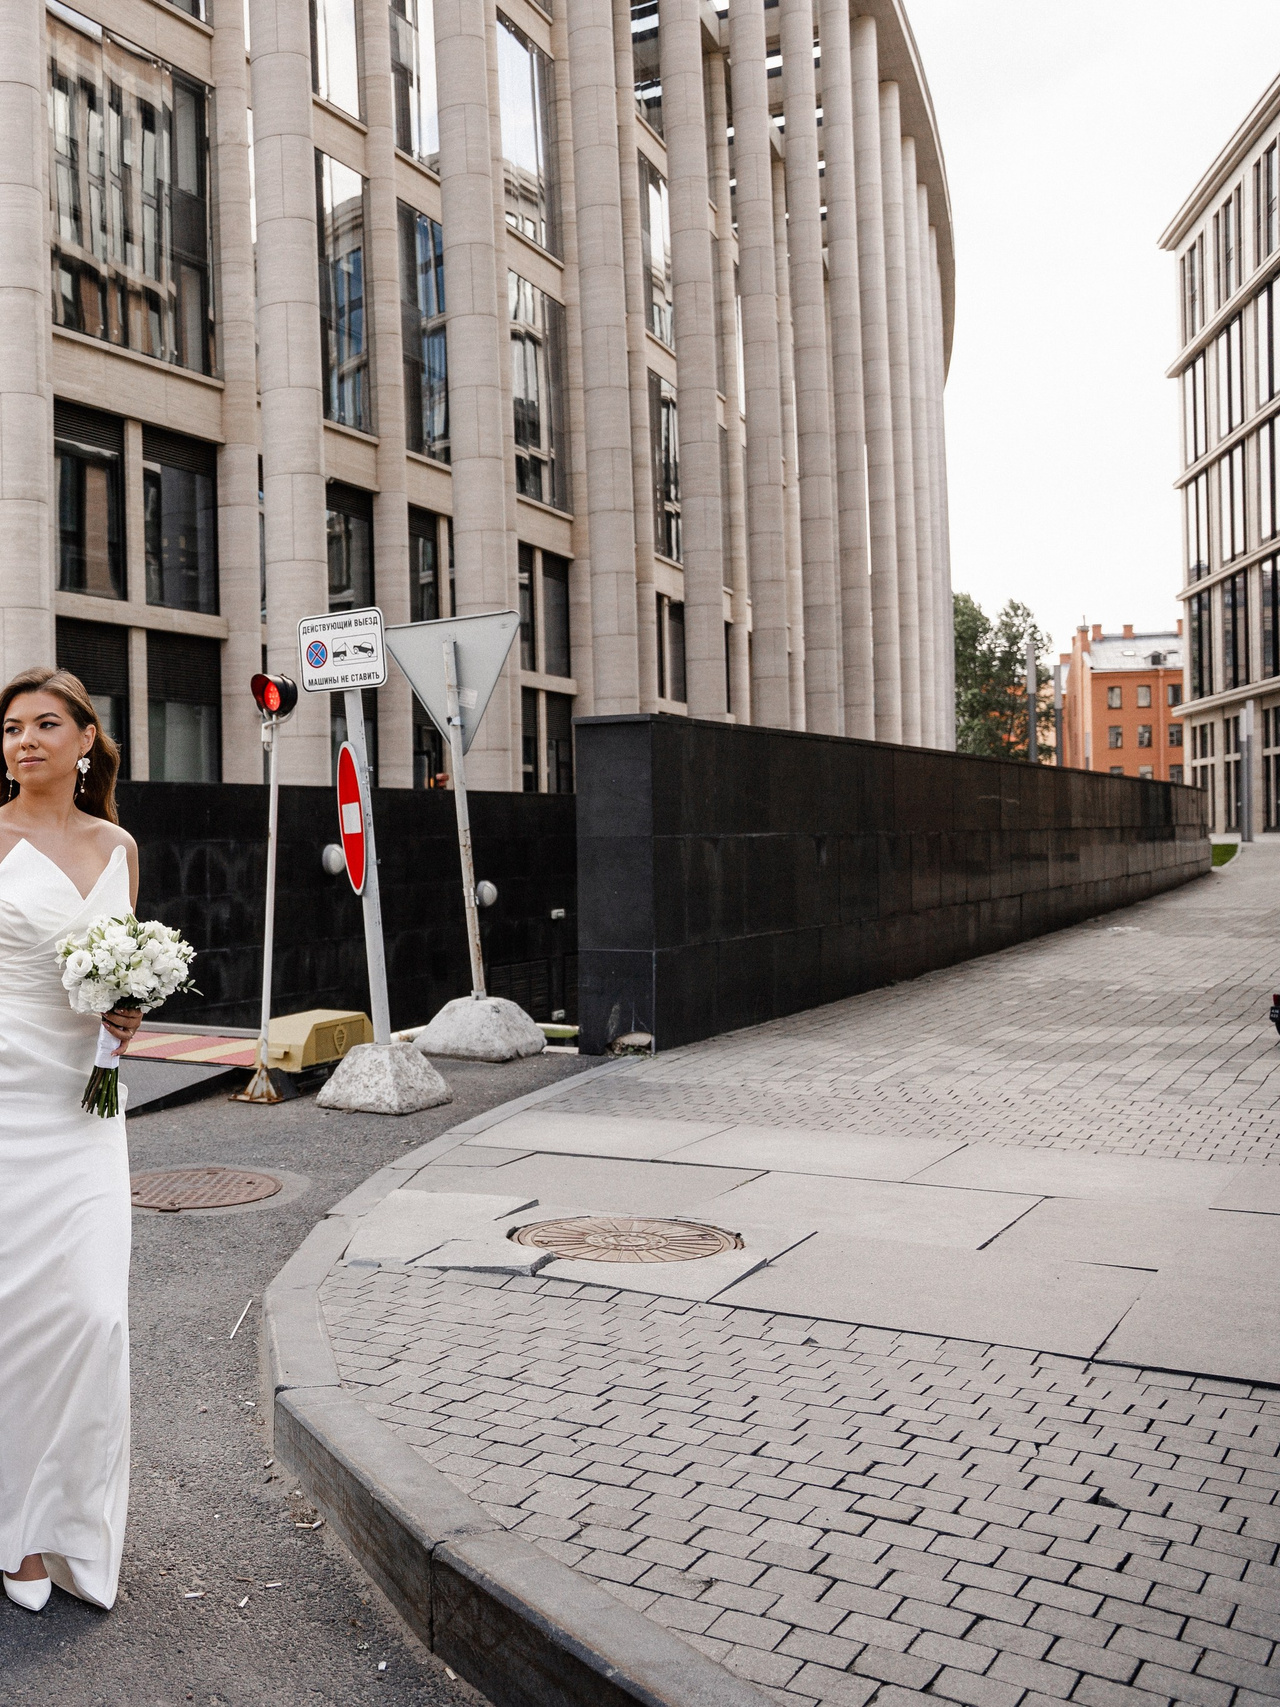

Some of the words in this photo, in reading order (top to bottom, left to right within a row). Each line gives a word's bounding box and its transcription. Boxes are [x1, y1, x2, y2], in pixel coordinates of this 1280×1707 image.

[303, 619, 352, 635] ДЕЙСТВУЮЩИЙ
[354, 616, 378, 627] ВЫЕЗД
[308, 676, 339, 687] МАШИНЫ
[341, 675, 349, 683] НЕ
[351, 672, 380, 682] СТАВИТЬ
